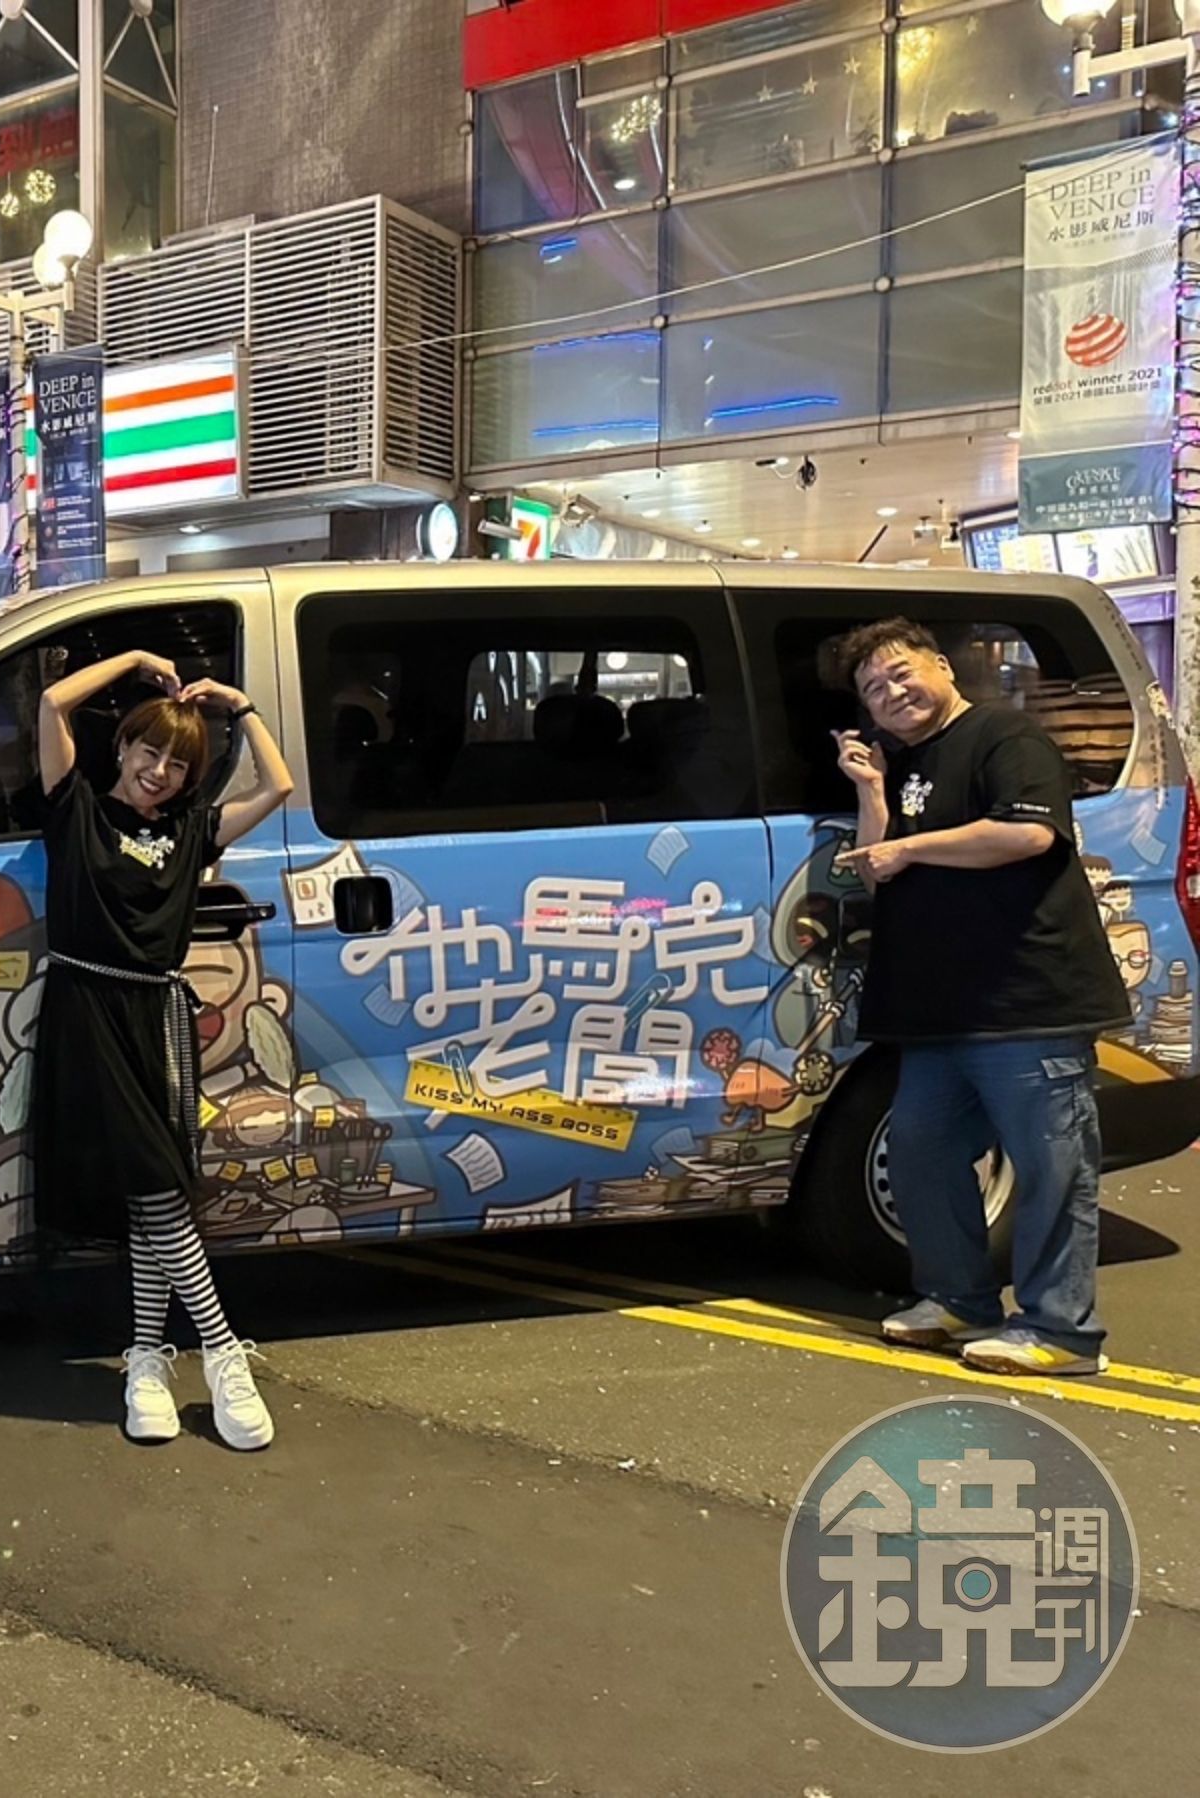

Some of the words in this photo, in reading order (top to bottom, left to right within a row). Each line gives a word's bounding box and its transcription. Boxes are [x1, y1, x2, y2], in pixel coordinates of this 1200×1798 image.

[1050, 170, 1122, 202] DEEP
[1130, 166, 1151, 185] in
[1050, 185, 1156, 220] VENICE
[1048, 210, 1155, 242] 水影威尼斯
[39, 375, 79, 397] DEEP
[81, 372, 95, 389] in
[1077, 373, 1123, 388] winner
[1127, 367, 1162, 381] 2021
[40, 389, 97, 414] VENICE
[414, 1083, 464, 1105] KISS
[510, 1107, 555, 1125] ASS
[561, 1117, 619, 1141] BOSS
